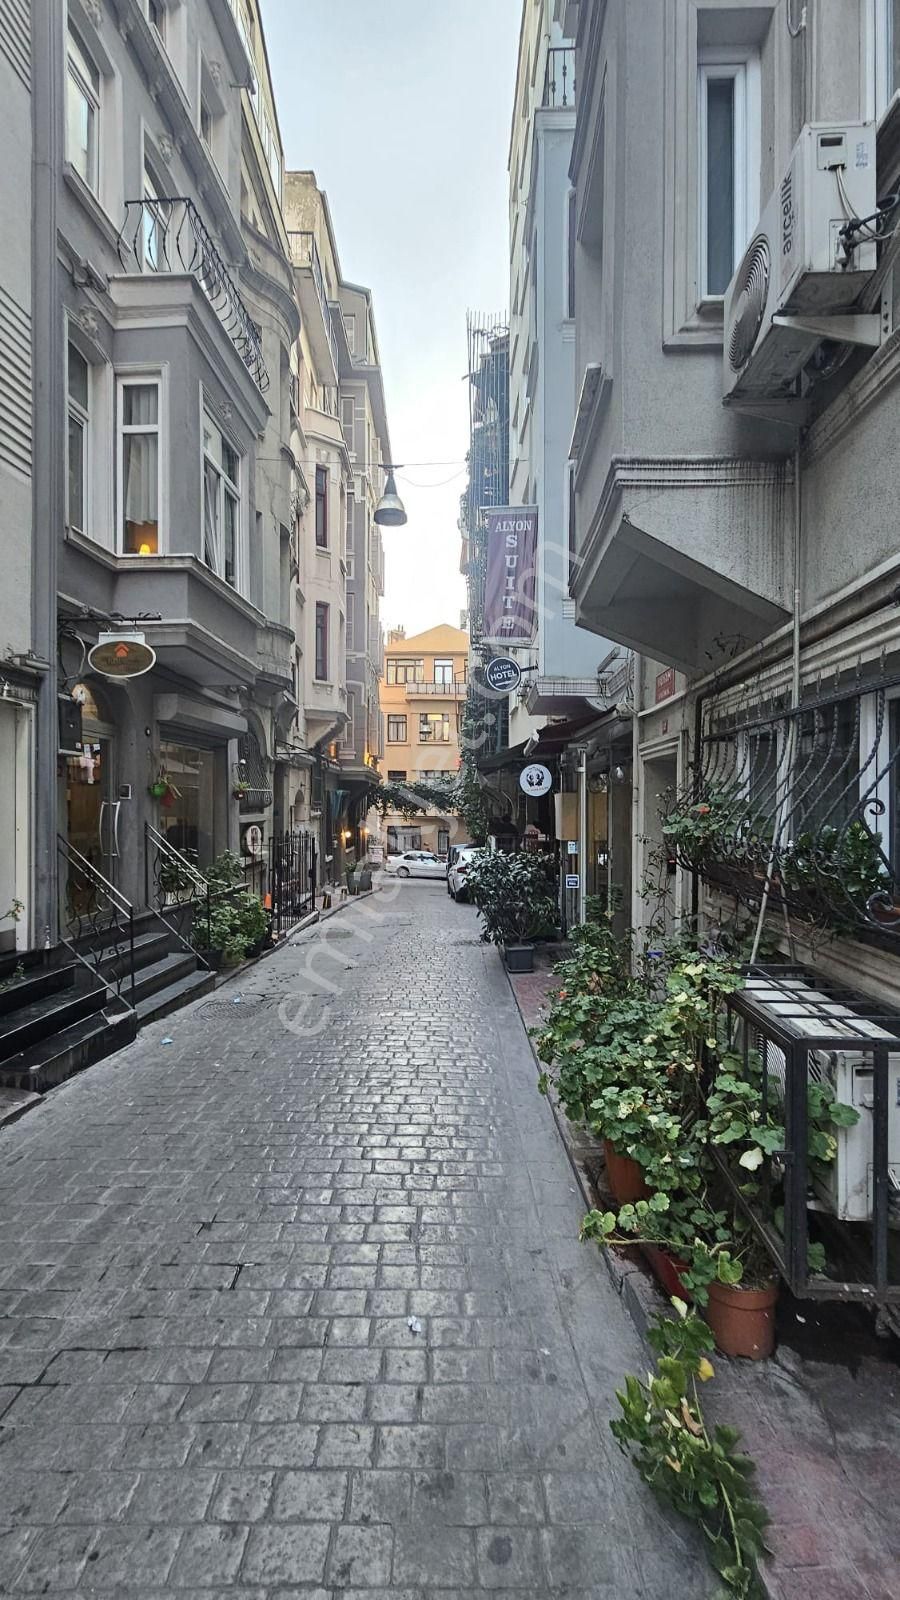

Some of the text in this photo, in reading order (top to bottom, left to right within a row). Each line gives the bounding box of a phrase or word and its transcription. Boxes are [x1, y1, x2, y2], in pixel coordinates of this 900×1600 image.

[495, 520, 532, 532] ALYON
[501, 534, 519, 629] SUITE
[490, 669, 517, 680] HOTEL
